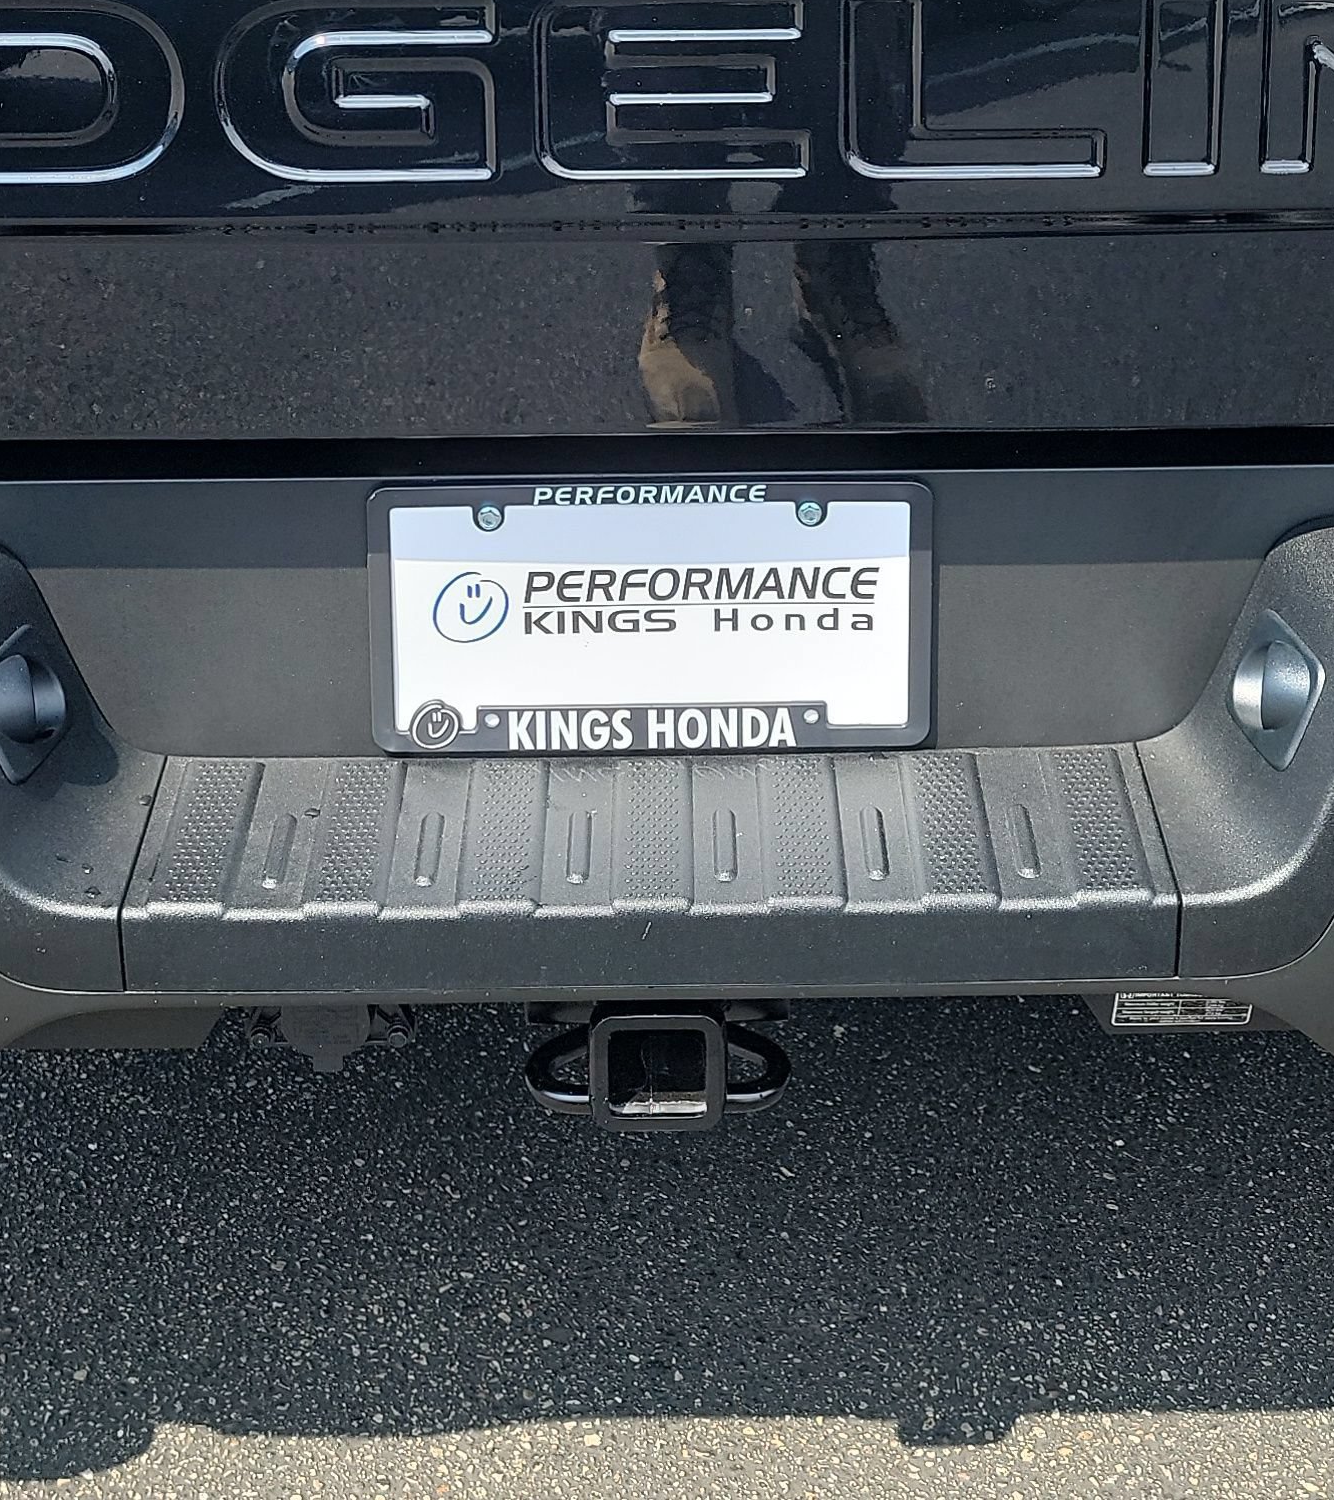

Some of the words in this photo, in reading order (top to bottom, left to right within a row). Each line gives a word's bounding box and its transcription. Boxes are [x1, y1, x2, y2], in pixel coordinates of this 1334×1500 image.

[533, 484, 767, 506] PERFORMANCE
[523, 566, 880, 604] PERFORMANCE
[523, 610, 678, 635] KINGS
[713, 607, 874, 632] Honda
[507, 709, 633, 751] KINGS
[648, 707, 798, 749] HONDA
